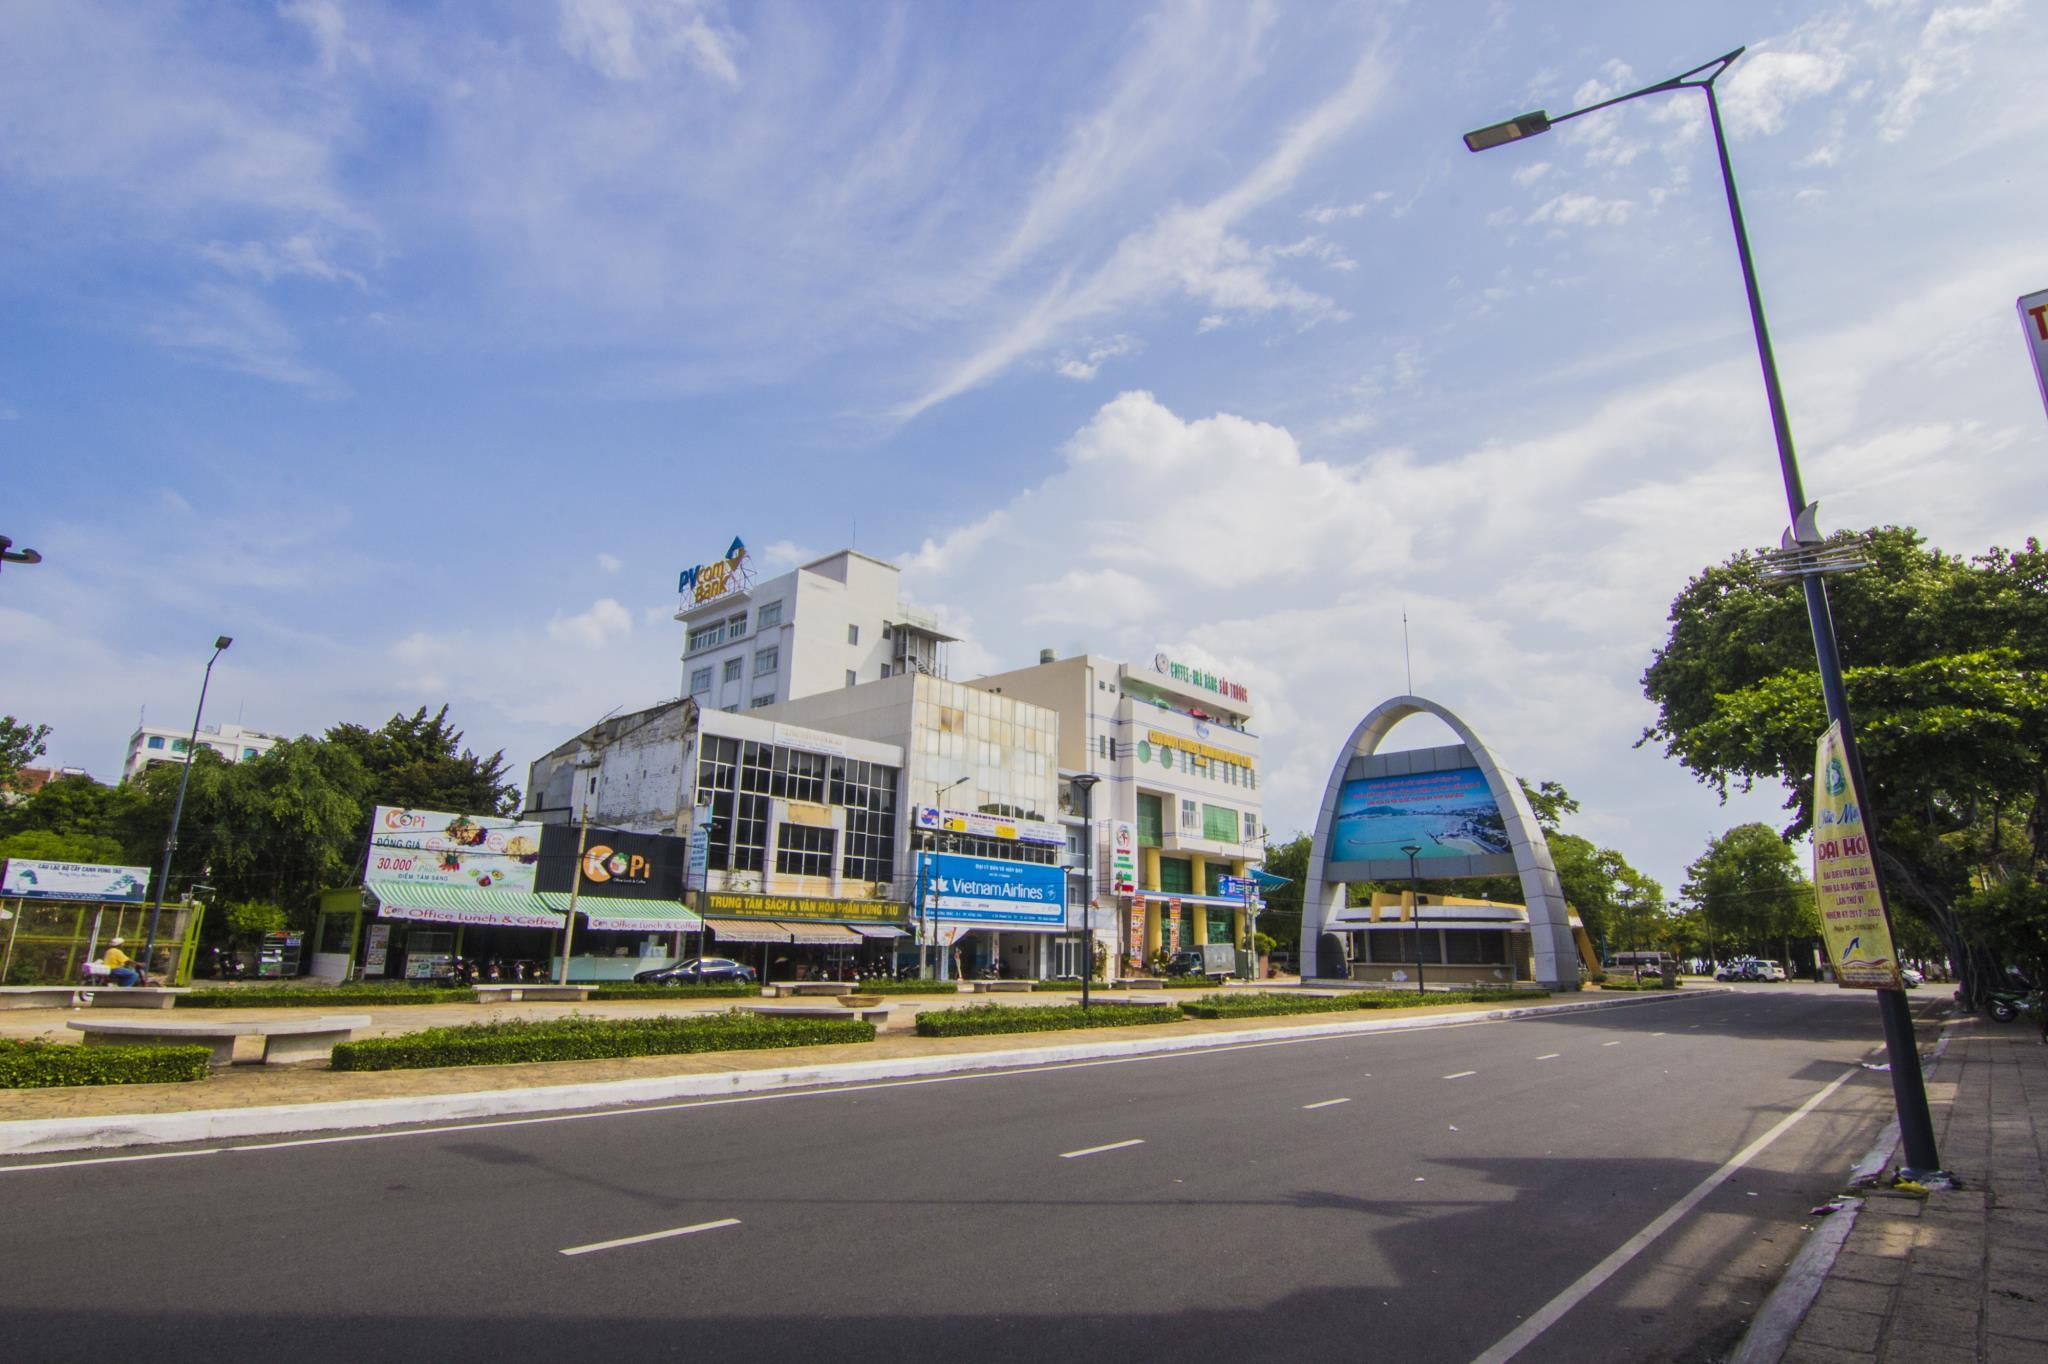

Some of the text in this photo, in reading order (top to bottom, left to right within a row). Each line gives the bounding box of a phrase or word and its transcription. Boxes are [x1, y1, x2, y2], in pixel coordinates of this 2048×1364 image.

[952, 877, 1043, 900] Vietnam Airlines
[710, 895, 742, 909] TRUNG
[790, 900, 797, 911] &
[408, 908, 454, 921] Office
[457, 912, 497, 923] Lunch
[502, 916, 512, 924] &
[664, 921, 671, 929] &
